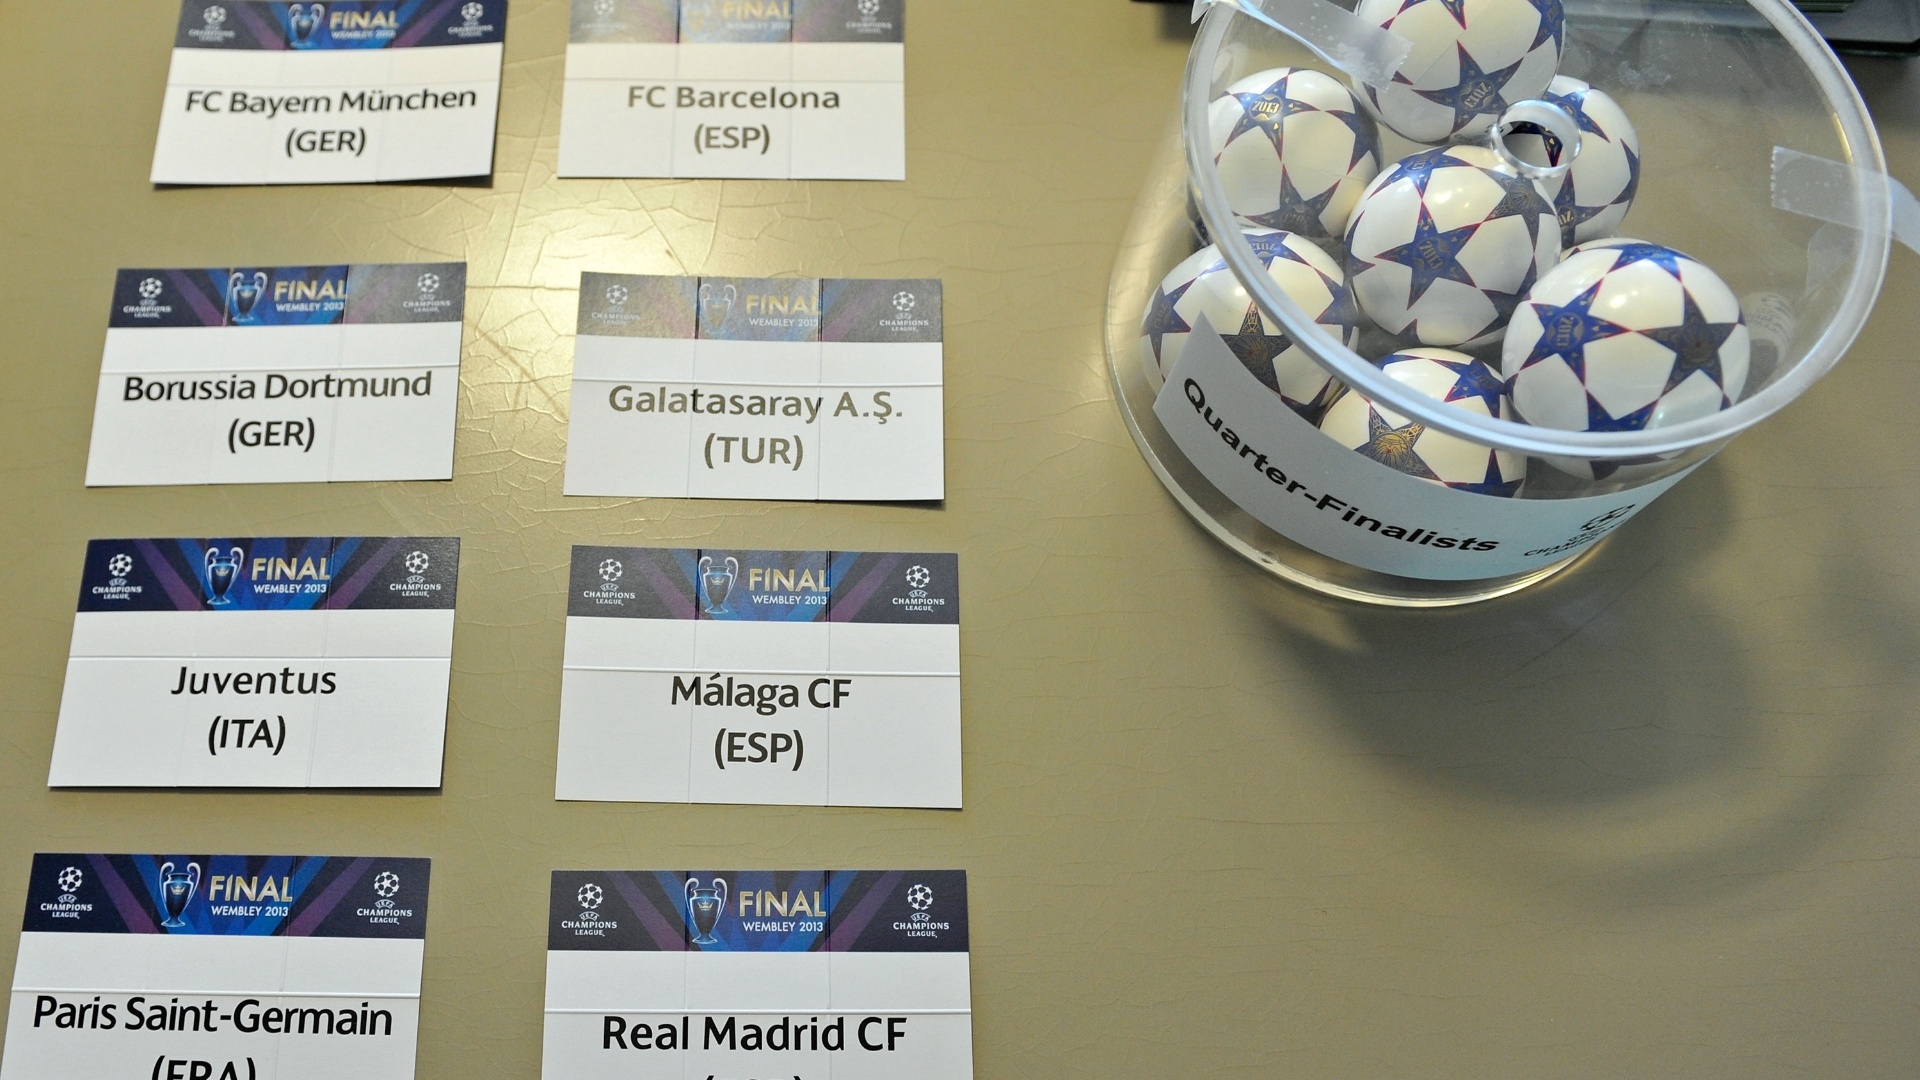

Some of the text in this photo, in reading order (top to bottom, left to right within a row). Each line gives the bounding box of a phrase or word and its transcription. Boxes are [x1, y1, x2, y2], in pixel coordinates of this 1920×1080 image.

[329, 10, 399, 29] FINAL
[722, 0, 792, 20] FINAL
[185, 88, 477, 119] FC Bayern München
[627, 86, 841, 109] FC Barcelona
[1251, 100, 1280, 114] 2013
[285, 127, 366, 157] (GER)
[693, 123, 770, 154] (ESP)
[274, 279, 347, 302] FINAL
[275, 301, 344, 312] WEMBLEY 2013
[402, 300, 451, 308] CHAMPIONS
[746, 294, 820, 316] FINAL
[591, 312, 641, 320] CHAMPIONS
[748, 318, 818, 327] WEMBLEY 2013
[122, 370, 432, 402] Borussia Dortmund
[608, 385, 903, 425] Galatasaray A.Ş.
[227, 417, 315, 453] (GER)
[703, 432, 804, 471] (TUR)
[1183, 377, 1500, 555] Quarter-Finalists
[251, 556, 331, 581] FINAL
[253, 583, 327, 594] WEMBLEY 2013
[389, 583, 442, 591] CHAMPIONS
[749, 567, 831, 592] FINAL
[92, 586, 142, 594] CHAMPIONS
[583, 590, 636, 599] CHAMPIONS
[752, 595, 828, 605] WEMBLEY 2013
[892, 597, 945, 605] CHAMPIONS
[170, 665, 337, 696] Juventus
[670, 672, 853, 716] Málaga CF
[208, 715, 287, 756] (ITA)
[713, 728, 805, 772] (ESP)
[209, 874, 293, 902] FINAL
[40, 903, 93, 911] CHAMPIONS
[58, 894, 77, 904] UEFA
[375, 899, 395, 909] UEFA
[739, 889, 827, 917] FINAL
[211, 905, 289, 917] WEMBLEY 2013
[356, 908, 413, 917] CHAMPIONS
[579, 911, 600, 921] UEFA
[910, 912, 932, 922] UEFA
[561, 921, 618, 929] CHAMPIONS
[743, 921, 824, 932] WEMBLEY 2013
[893, 922, 950, 931] CHAMPIONS
[33, 994, 393, 1036] Paris Saint-Germain
[602, 1015, 908, 1051] Real Madrid CF
